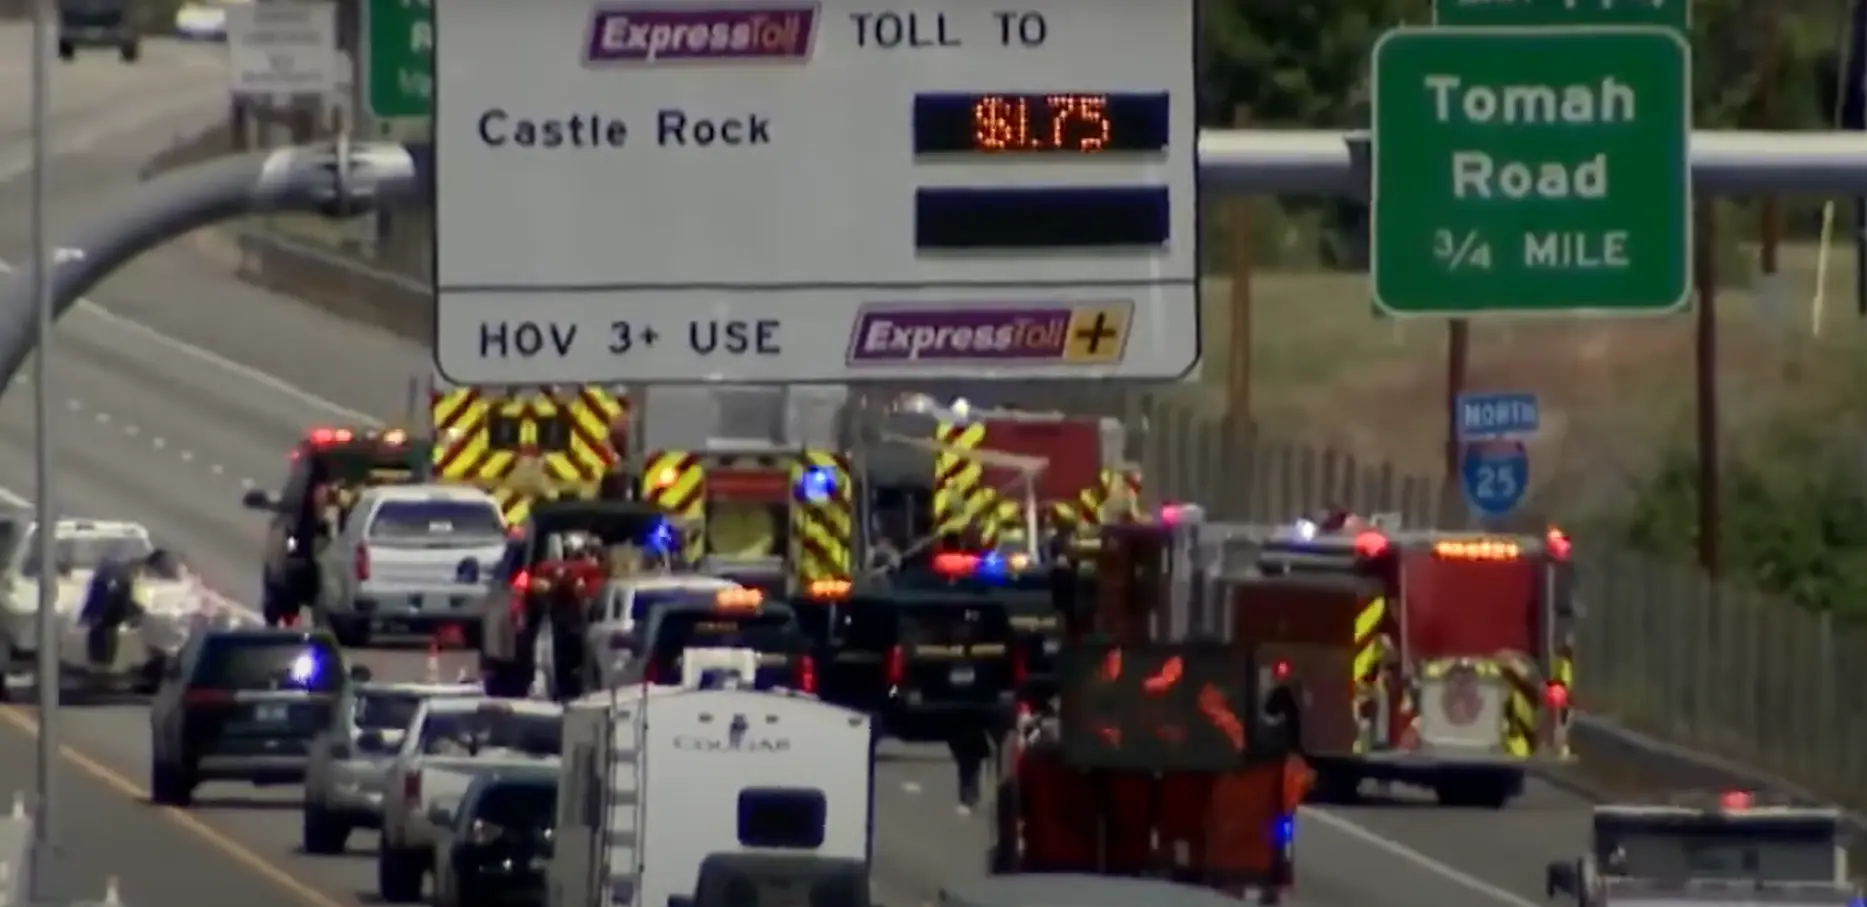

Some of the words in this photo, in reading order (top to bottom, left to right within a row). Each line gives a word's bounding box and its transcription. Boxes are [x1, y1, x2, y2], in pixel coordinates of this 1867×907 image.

[849, 10, 963, 48] TOLL
[992, 10, 1047, 48] TO
[1424, 74, 1636, 124] Tomah
[478, 107, 628, 148] Castle
[656, 108, 771, 147] Rock
[976, 95, 1111, 152] $1.75
[1453, 150, 1608, 199] Road
[1523, 230, 1630, 268] MILE
[480, 320, 578, 358] HOV
[608, 320, 660, 355] 3+
[689, 319, 781, 356] USE
[1475, 464, 1518, 499] 25
